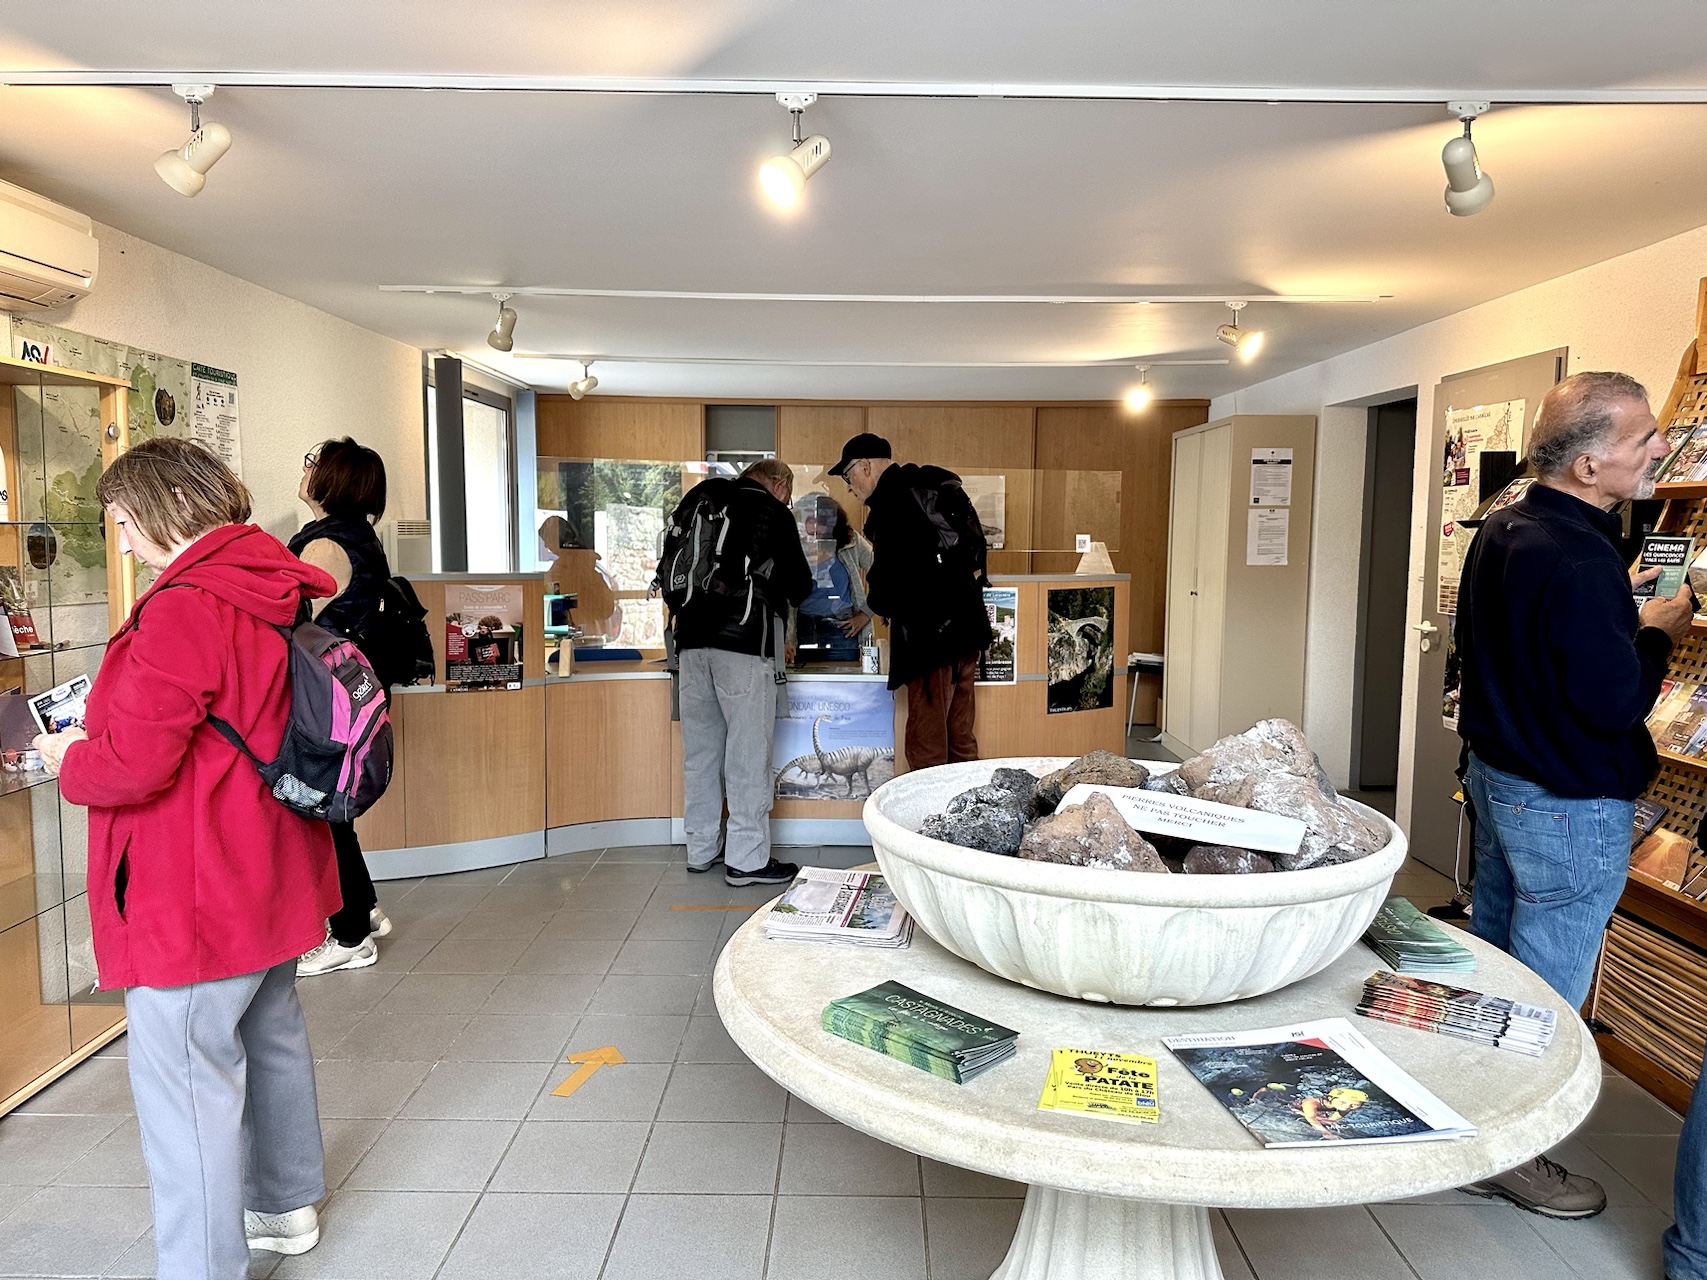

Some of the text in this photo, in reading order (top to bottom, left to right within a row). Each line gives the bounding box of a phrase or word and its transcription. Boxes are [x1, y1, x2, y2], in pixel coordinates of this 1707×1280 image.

[1647, 543, 1685, 552] CINEMA
[12, 625, 34, 634] èche
[788, 701, 851, 711] ONDIAL UNESCO
[1122, 794, 1246, 823] PIERRES VOLCANIQUES
[1132, 803, 1227, 828] NE PAS TOUCHER
[1157, 816, 1193, 828] MERCI
[885, 994, 982, 1035] CASTAGNADES
[1167, 1035, 1236, 1044] DESTINATION
[1068, 1049, 1122, 1058] THUEYTS
[1107, 1057, 1153, 1066] novembre
[1107, 1067, 1150, 1078] Fête
[1085, 1076, 1154, 1090] PATATE
[1350, 1117, 1414, 1129] TOURISTIQUE
